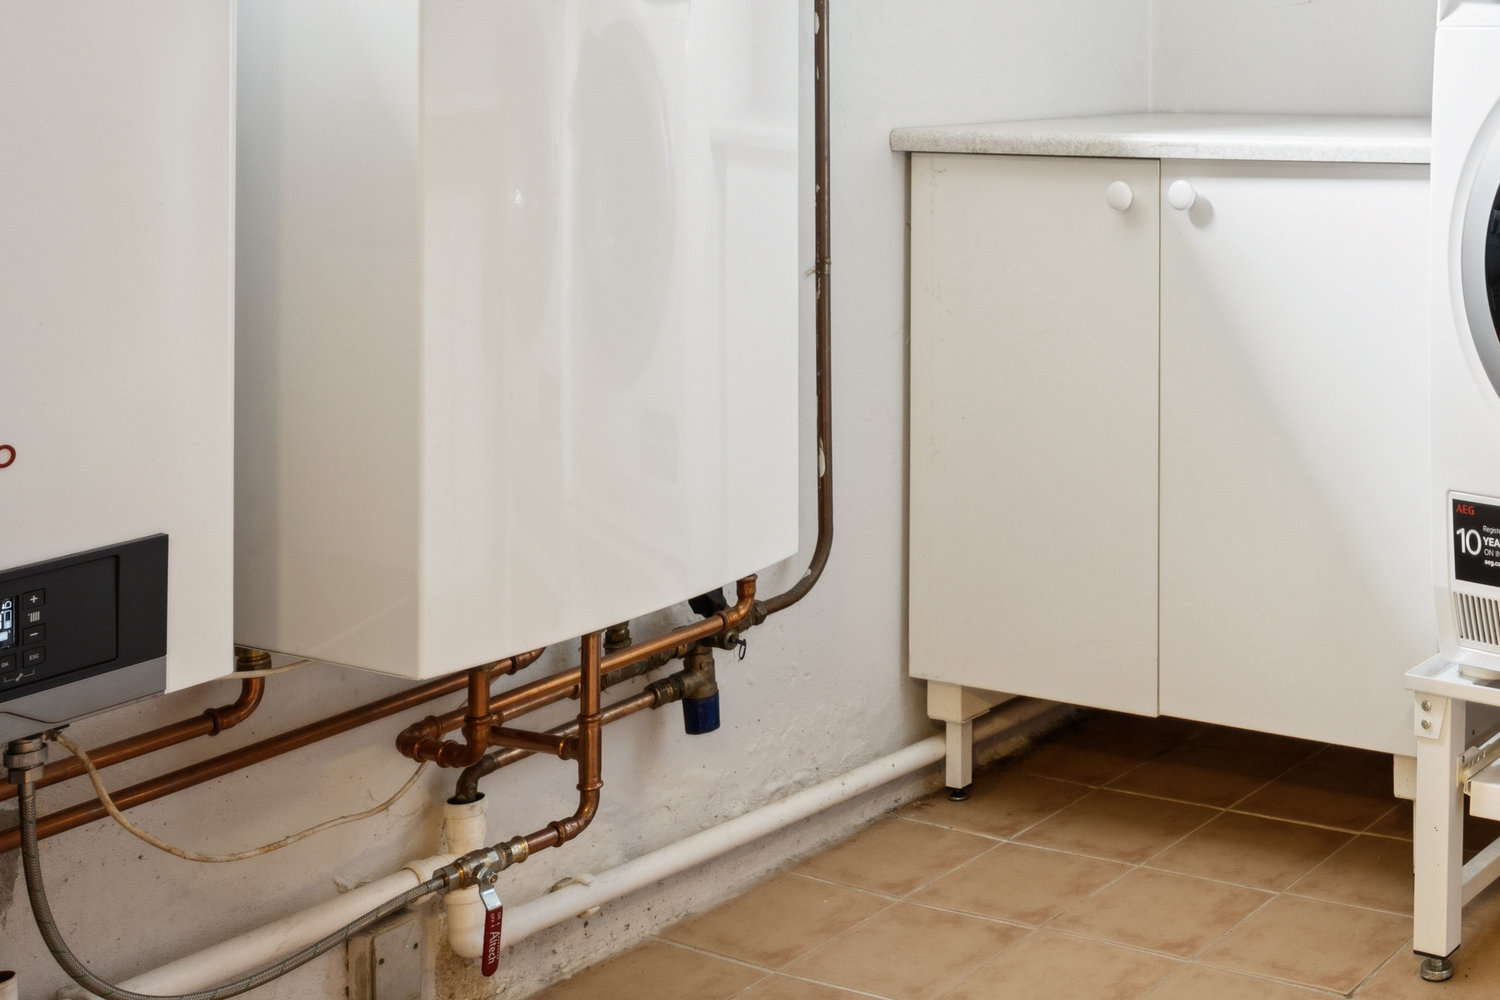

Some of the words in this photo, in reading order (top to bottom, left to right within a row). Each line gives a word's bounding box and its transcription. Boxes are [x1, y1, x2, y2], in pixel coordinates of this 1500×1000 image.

[1456, 504, 1475, 515] AEG
[1456, 527, 1482, 556] 10
[1483, 549, 1494, 557] ON
[488, 931, 501, 965] Altech
